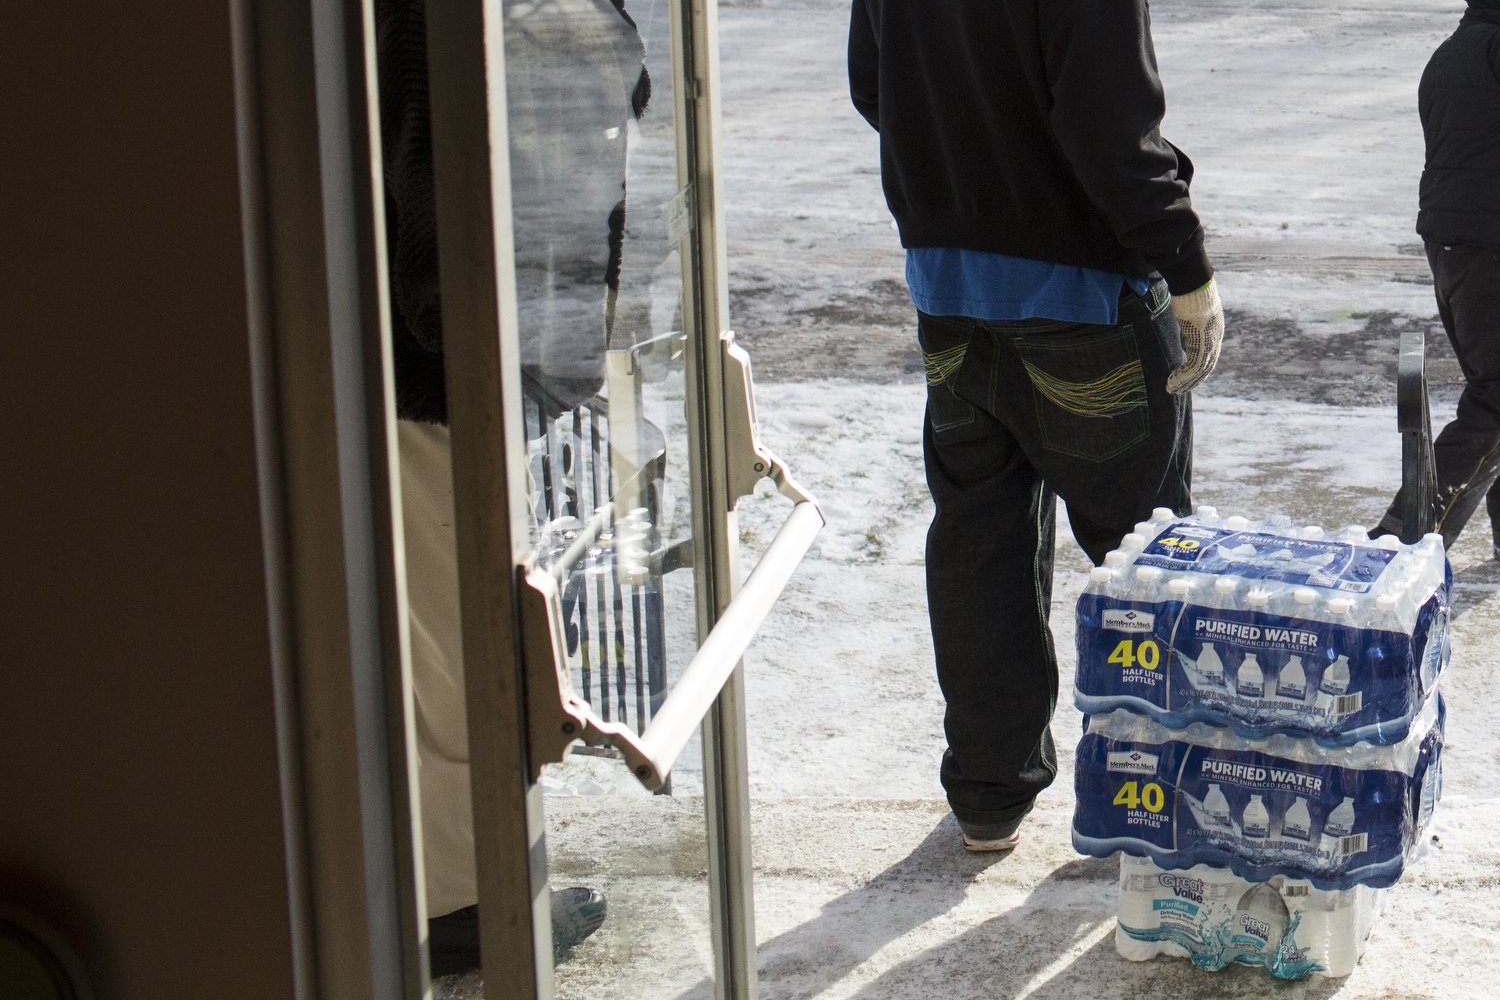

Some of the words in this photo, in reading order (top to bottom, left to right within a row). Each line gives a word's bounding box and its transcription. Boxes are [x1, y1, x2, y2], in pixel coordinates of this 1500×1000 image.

[1158, 537, 1200, 549] 40
[1195, 619, 1261, 640] PURIFIED
[1265, 629, 1318, 647] WATER
[1205, 632, 1235, 642] MINERAL
[1287, 643, 1308, 651] TASTE
[1107, 640, 1160, 670] 40
[1122, 668, 1143, 677] HALF
[1144, 670, 1164, 681] LITER
[1122, 676, 1156, 686] BOTTLES
[1201, 760, 1267, 781] PURIFIED
[1270, 770, 1323, 791] WATER
[1211, 774, 1240, 784] MINERAL
[1292, 785, 1314, 794] TASTE
[1112, 781, 1165, 813] 40
[1127, 810, 1148, 818] HALF
[1149, 812, 1169, 822] LITER
[1127, 817, 1161, 828] BOTTLES
[1158, 872, 1204, 895] Great
[1172, 887, 1204, 904] Value
[1240, 913, 1271, 934] Great
[1244, 925, 1269, 942] Value
